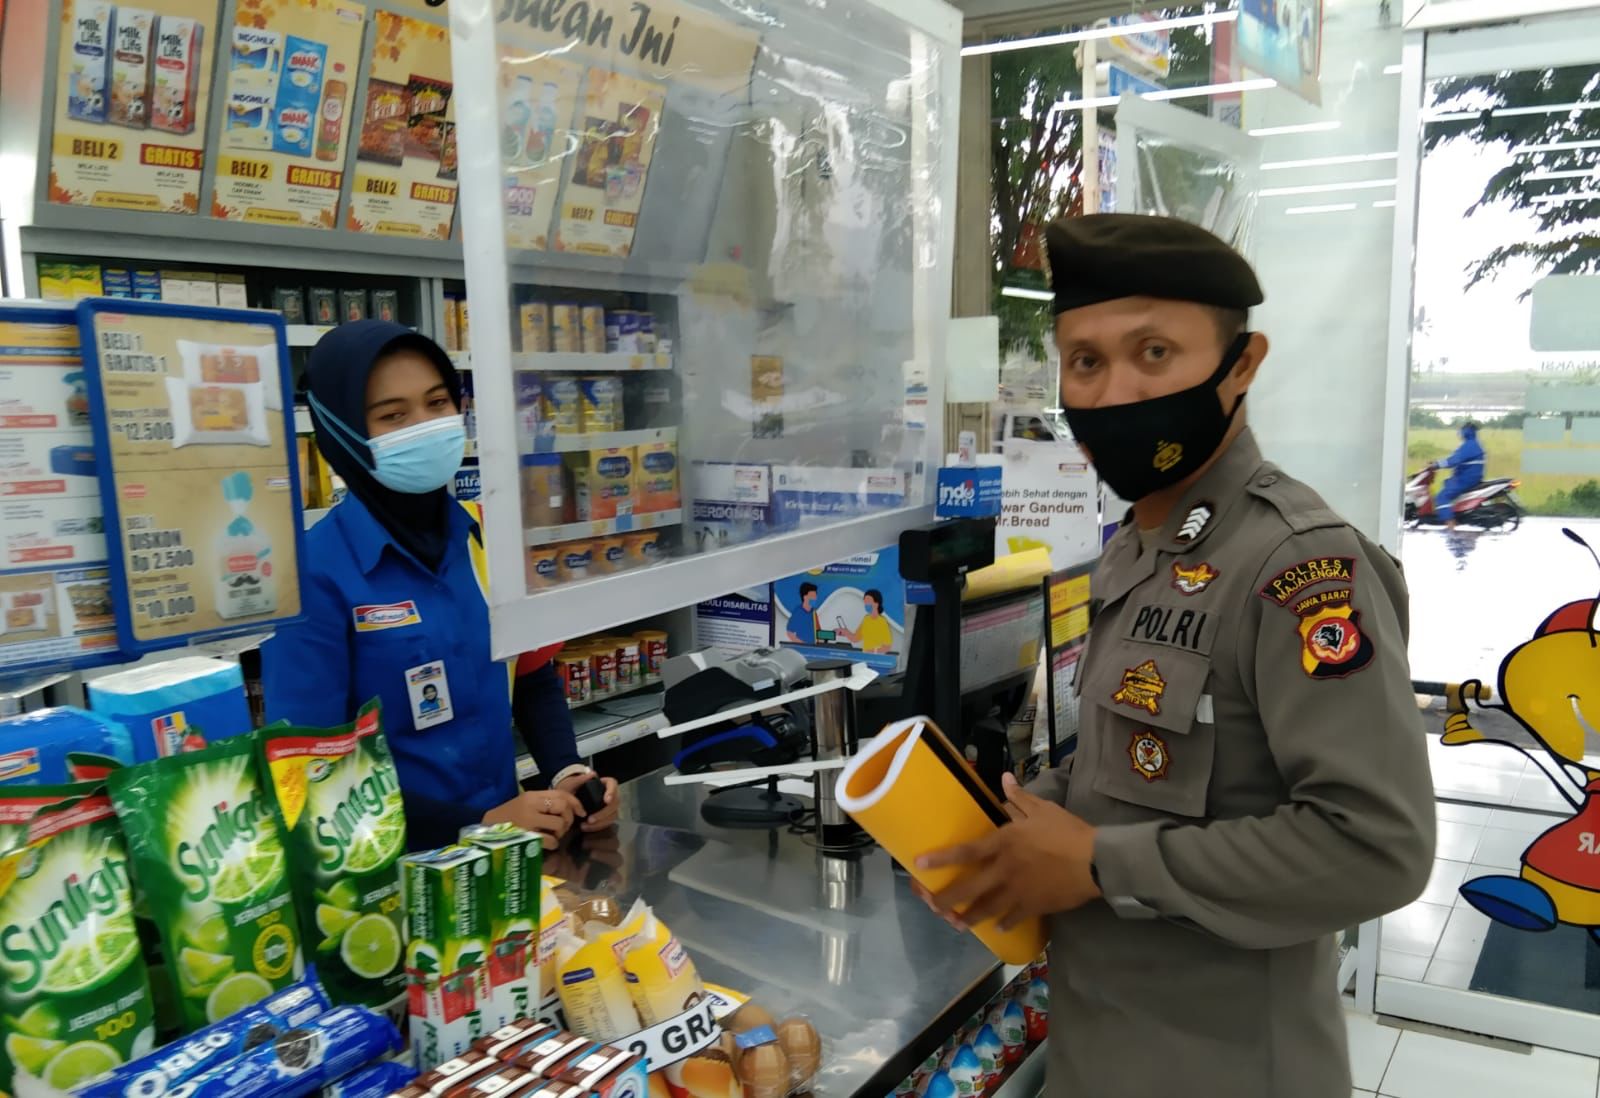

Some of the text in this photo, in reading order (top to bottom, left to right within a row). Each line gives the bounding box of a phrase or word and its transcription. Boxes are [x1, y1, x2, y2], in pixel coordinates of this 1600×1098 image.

[72, 139, 118, 159] BELI 2
[144, 147, 195, 168] GRATIS
[231, 160, 269, 179] BELI 2
[291, 168, 342, 188] GRATIS 1
[366, 178, 398, 195] BELI 2
[413, 184, 450, 201] GRATIS
[1023, 489, 1050, 498] Sehat
[1052, 489, 1088, 500] dengan
[1029, 502, 1085, 513] Gandum
[1273, 559, 1342, 591] POLRES
[1276, 568, 1350, 601] MAJALENGKA
[723, 600, 768, 612] DISABILITAS
[1296, 590, 1350, 613] JAWA BARAT
[1131, 606, 1207, 650] POLRI
[94, 1011, 136, 1041] 100
[125, 1030, 232, 1098] OREO
